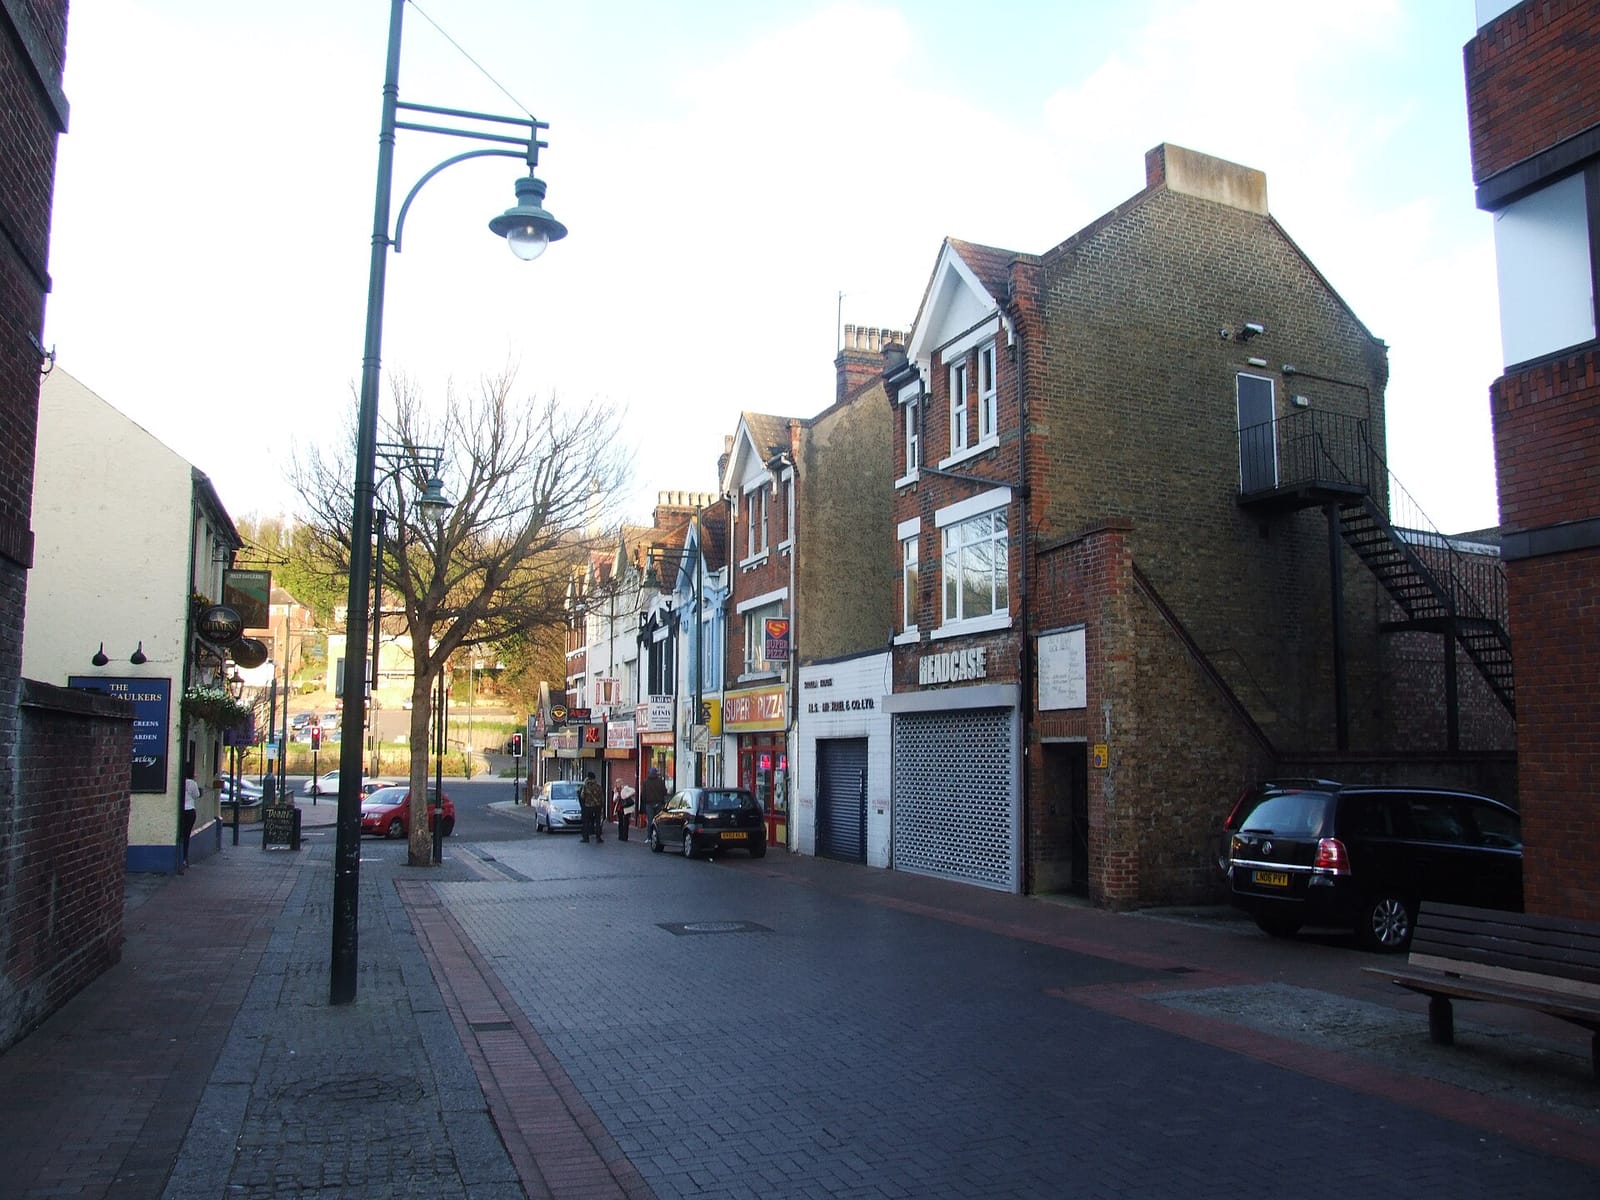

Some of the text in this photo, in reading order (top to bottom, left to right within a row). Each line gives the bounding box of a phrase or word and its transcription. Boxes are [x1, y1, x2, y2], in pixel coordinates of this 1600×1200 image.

[766, 639, 788, 649] SUPER
[766, 650, 788, 659] PIZZA
[919, 646, 987, 686] HEADCASE
[725, 693, 785, 721] SUPER PIZZA
